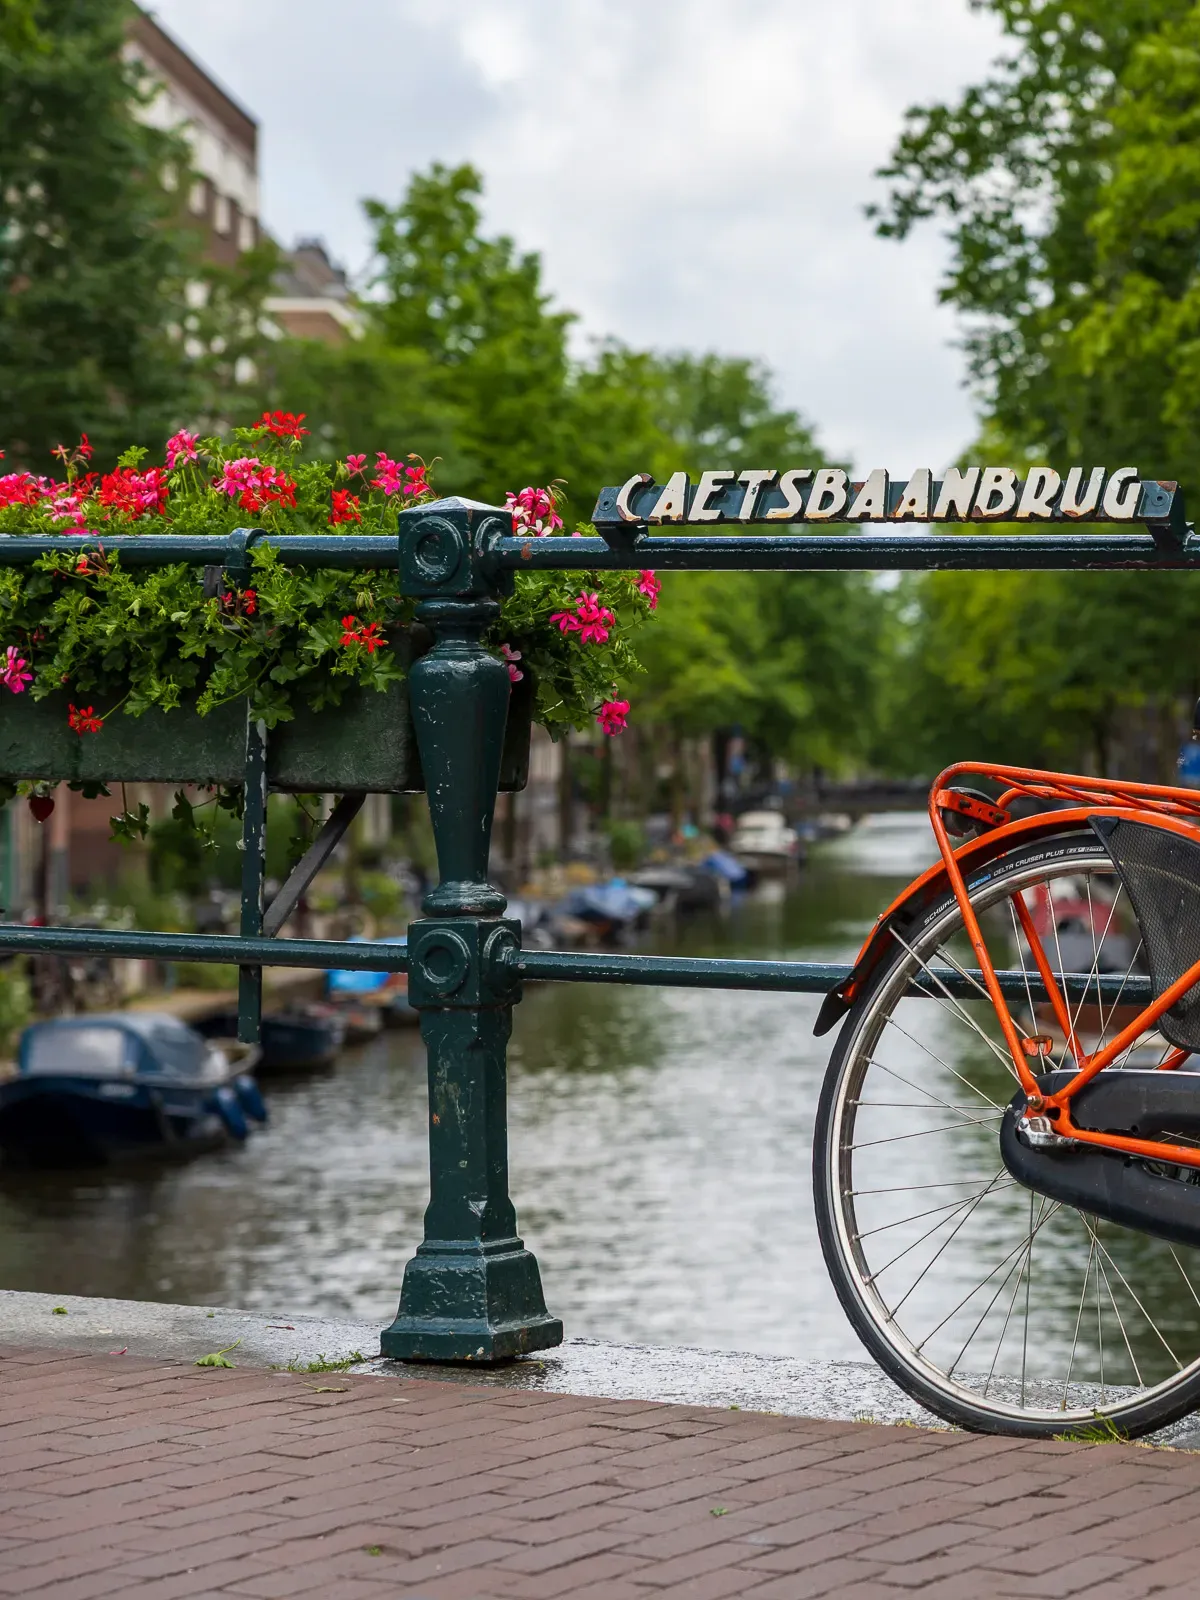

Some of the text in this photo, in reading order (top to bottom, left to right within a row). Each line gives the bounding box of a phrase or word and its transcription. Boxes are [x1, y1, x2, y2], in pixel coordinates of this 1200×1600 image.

[615, 466, 1144, 522] CAETSBAANBRUG
[923, 894, 958, 926] SCHWAL
[993, 863, 1015, 878] DELTA
[1015, 853, 1045, 869] CRUISER
[1045, 848, 1065, 860] PLUS
